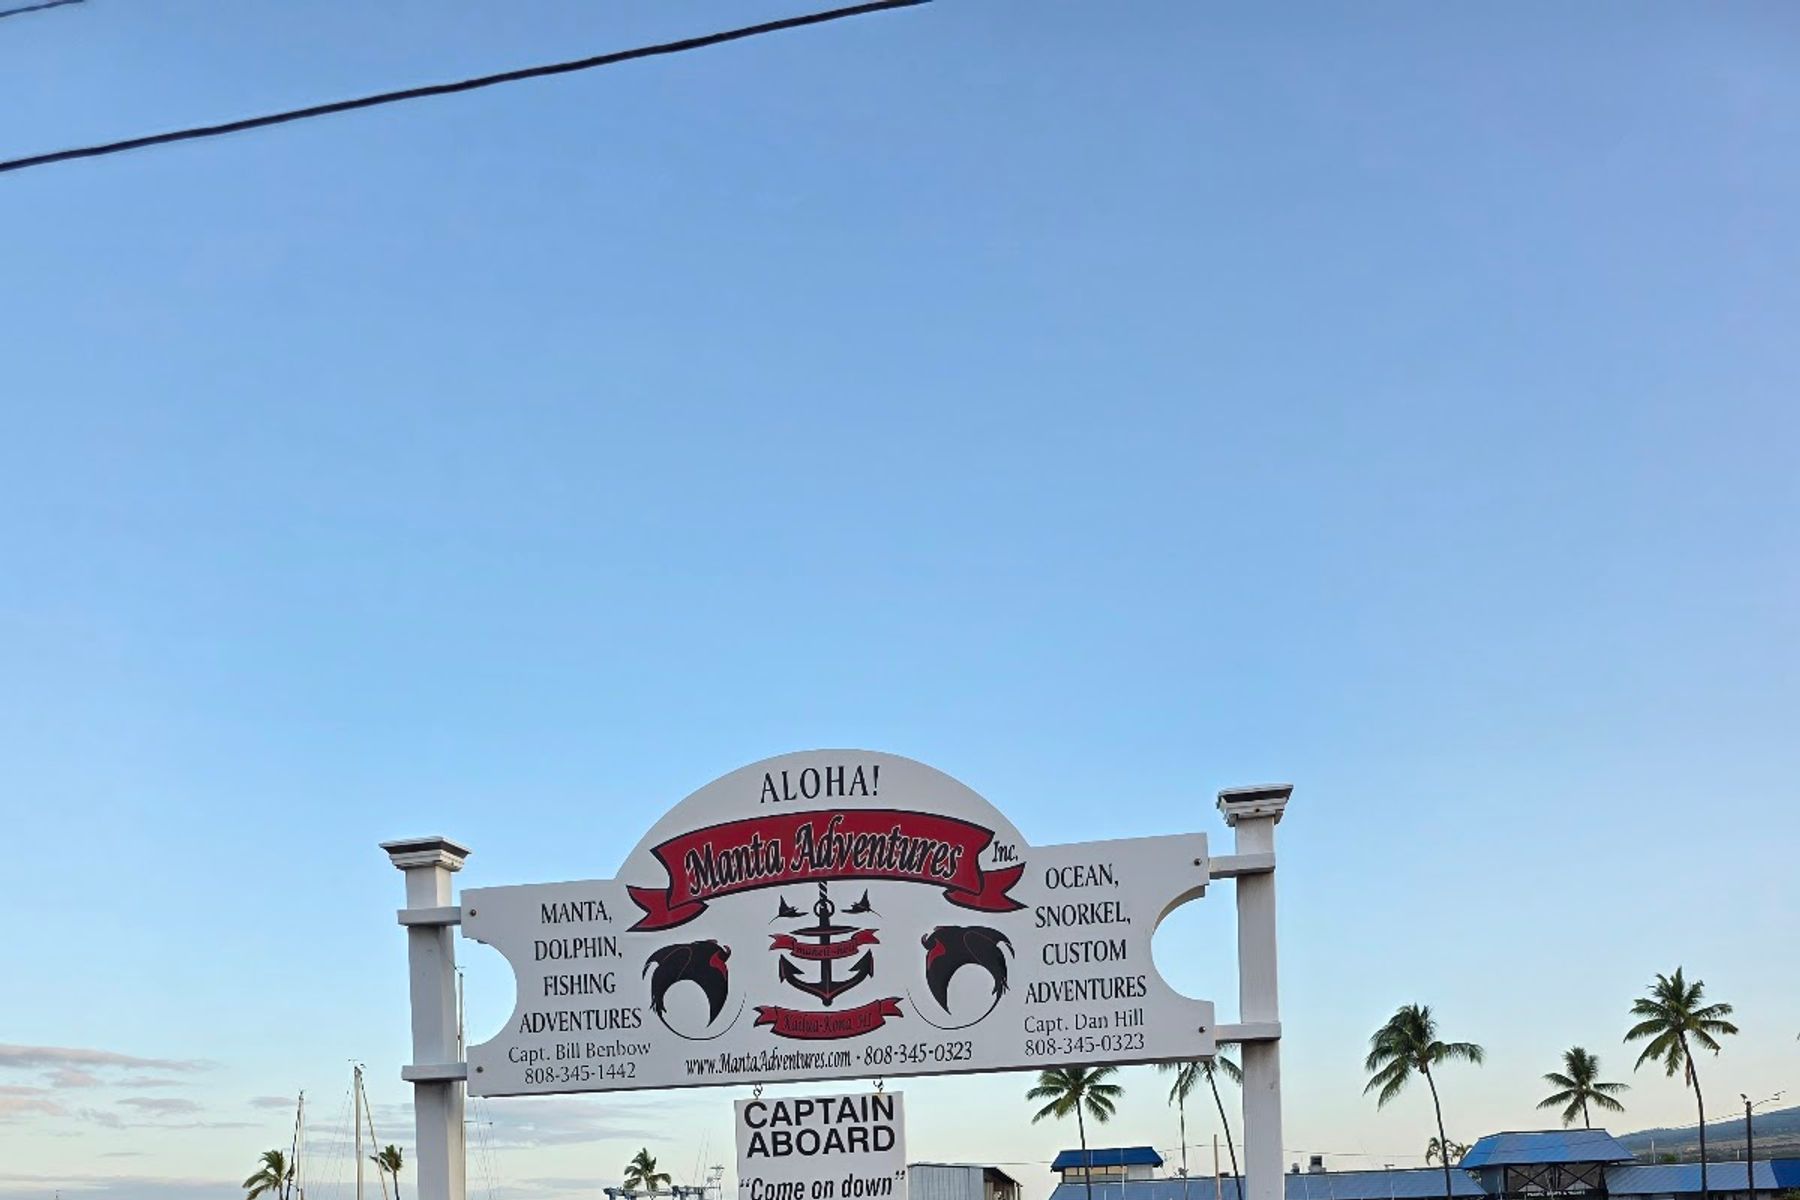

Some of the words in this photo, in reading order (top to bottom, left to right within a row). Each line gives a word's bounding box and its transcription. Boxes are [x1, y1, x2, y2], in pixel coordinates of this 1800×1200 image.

[760, 765, 880, 803] ALOHA!
[685, 832, 785, 896] Manta
[790, 814, 963, 879] Adventures
[991, 840, 1019, 863] Inc.
[1045, 863, 1119, 889] OCEAN,
[541, 900, 613, 925] MANTA,
[1035, 903, 1131, 928] SNORKEL,
[534, 936, 623, 961] DOLPHIN,
[1042, 939, 1127, 966] CUSTOM
[543, 972, 617, 997] FISHING
[1025, 975, 1147, 1004] ADVENTURES
[519, 1008, 642, 1034] ADVENTURES
[1024, 1014, 1069, 1035] Capt.
[1075, 1011, 1109, 1030] Dan
[1115, 1007, 1145, 1026] Hill
[508, 1046, 551, 1065] Capt.
[556, 1043, 580, 1060] Bill
[586, 1040, 652, 1058] Benbow
[685, 1046, 852, 1075] www.MantaAdventures.com
[864, 1040, 973, 1066] 808-345-0323
[1024, 1033, 1145, 1056] 808-345-0323
[525, 1062, 636, 1085] 808-345-1442
[744, 1095, 894, 1129] CAPTAIN
[747, 1125, 896, 1158] ABOARD
[811, 1179, 834, 1200] on
